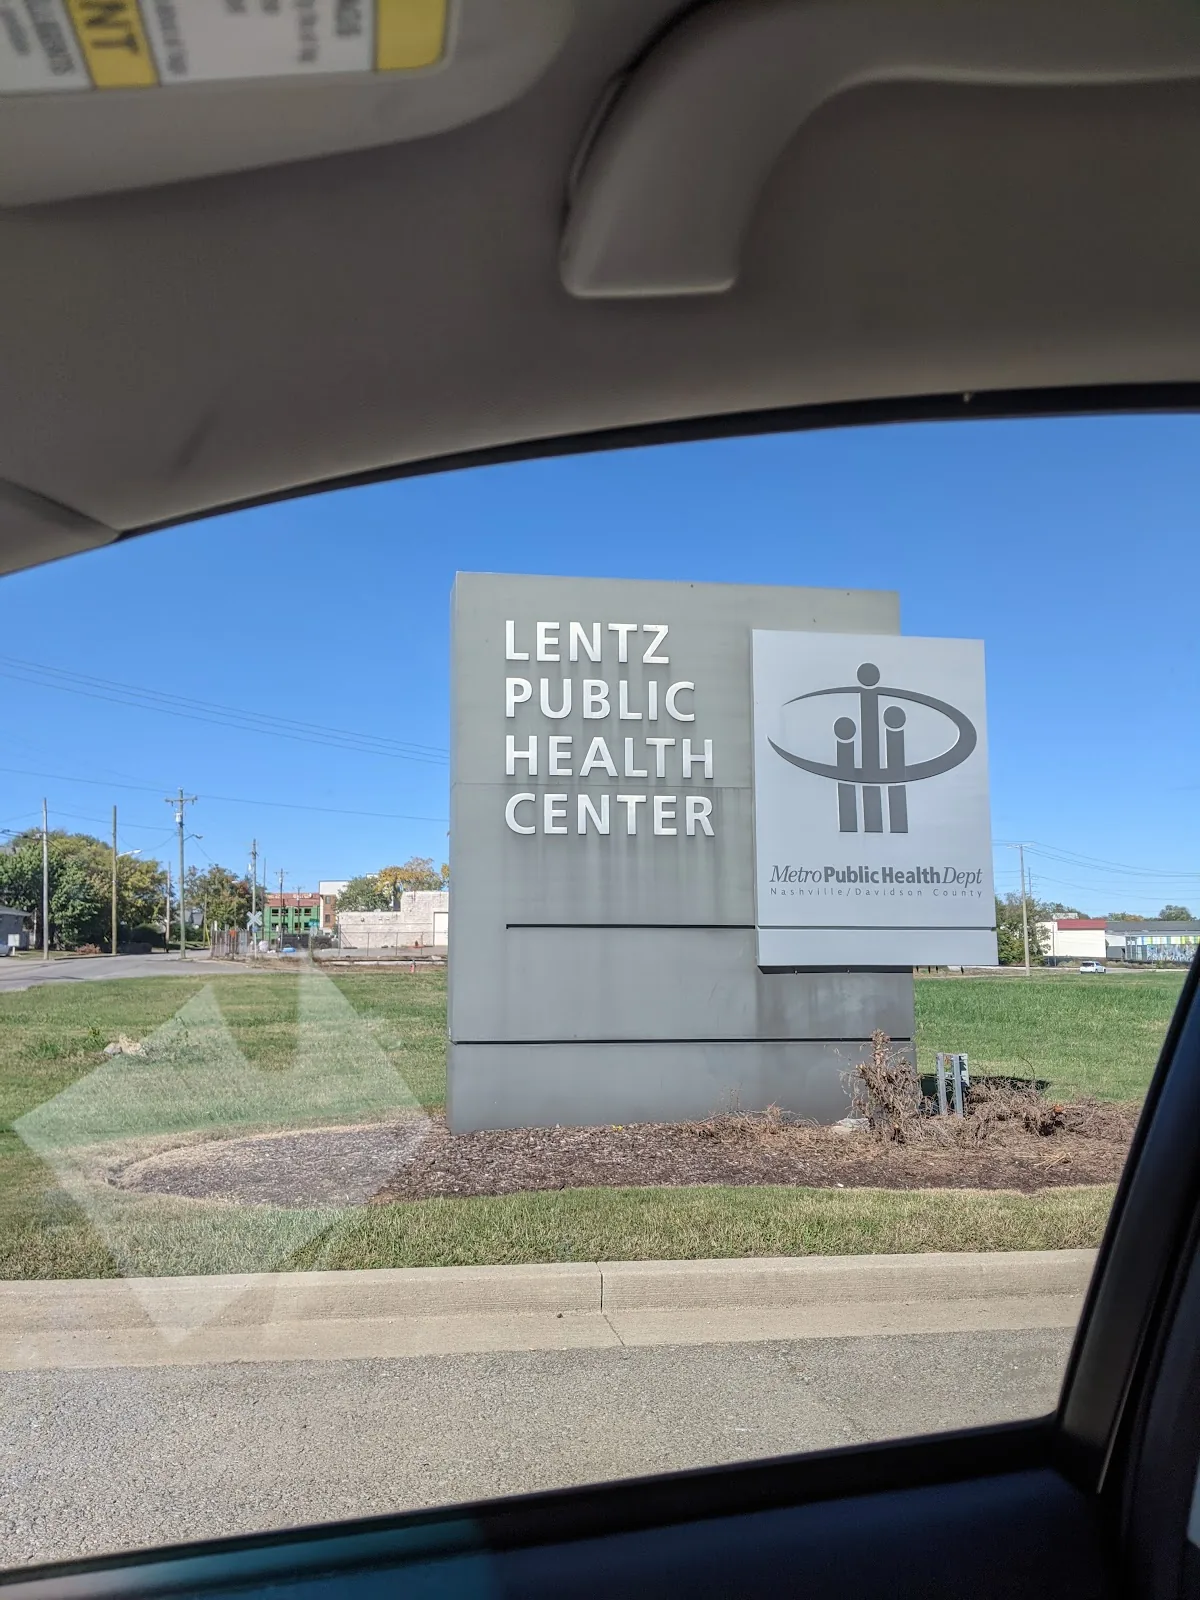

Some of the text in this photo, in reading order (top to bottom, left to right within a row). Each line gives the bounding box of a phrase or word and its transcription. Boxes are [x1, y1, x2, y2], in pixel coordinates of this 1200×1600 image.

[504, 619, 670, 665] LENTZ
[504, 676, 696, 723] PUBLIC
[504, 734, 714, 780] HEALTH
[504, 792, 716, 837] CENTER
[933, 888, 983, 898] County
